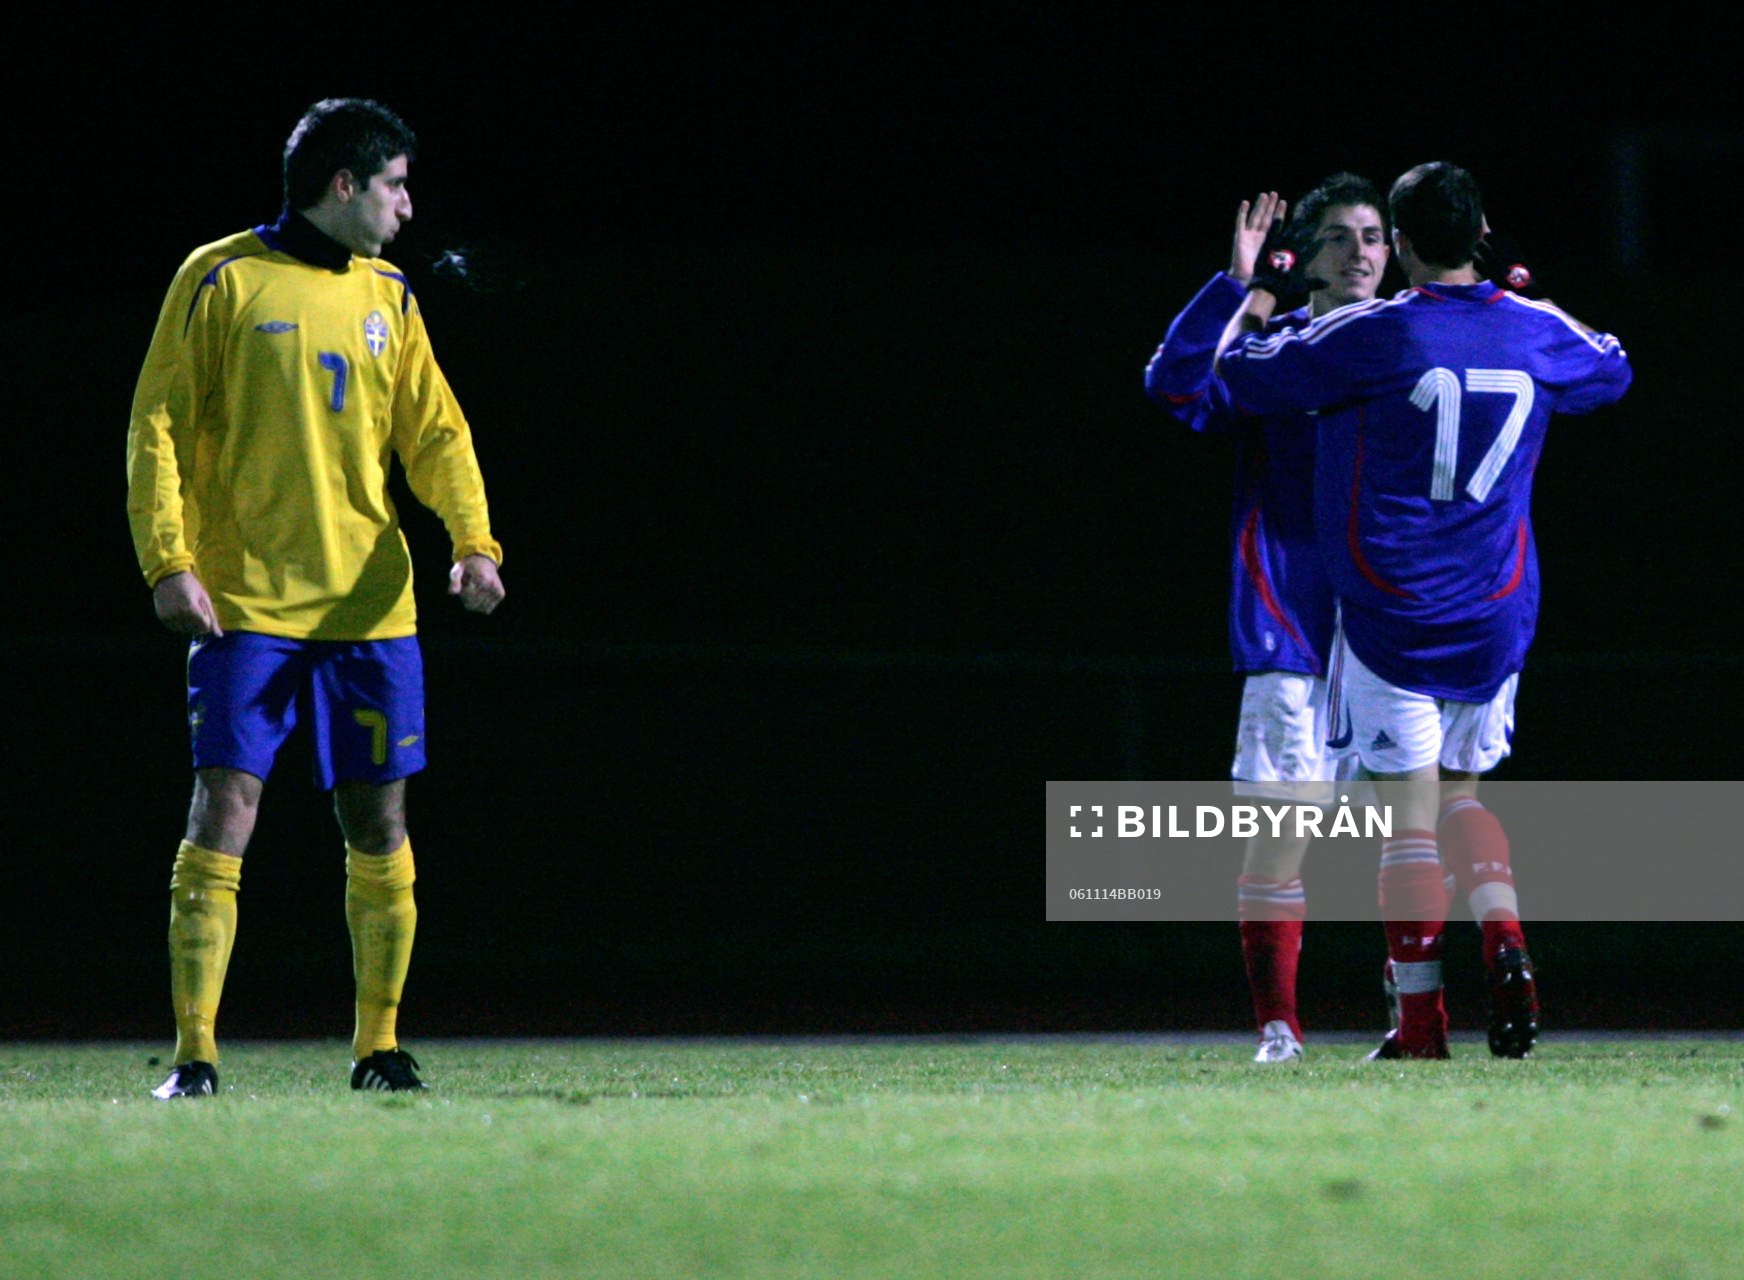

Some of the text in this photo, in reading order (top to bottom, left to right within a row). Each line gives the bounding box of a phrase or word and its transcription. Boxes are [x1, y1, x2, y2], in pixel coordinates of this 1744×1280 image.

[317, 351, 348, 412] 7
[1409, 366, 1535, 503] 17
[354, 708, 387, 765] 7
